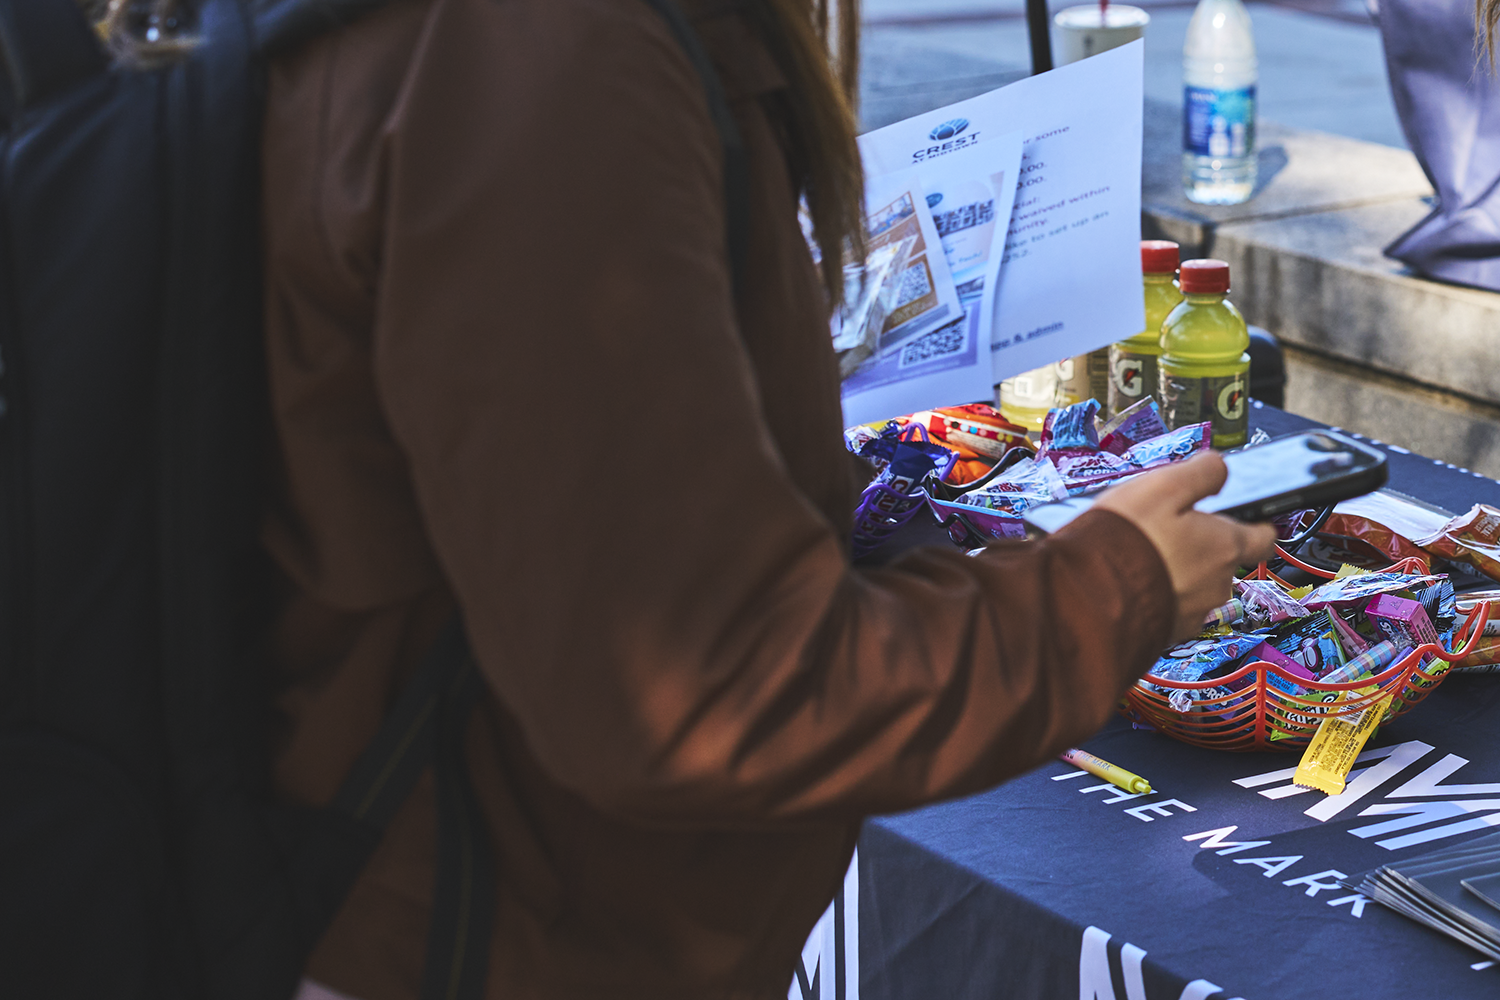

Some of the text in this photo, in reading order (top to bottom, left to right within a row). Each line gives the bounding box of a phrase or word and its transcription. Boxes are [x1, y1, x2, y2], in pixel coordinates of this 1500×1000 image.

[912, 132, 980, 158] CREST
[1035, 126, 1070, 142] some
[928, 140, 978, 160] MIDTOWN
[1116, 359, 1142, 397] G
[1217, 379, 1244, 420] G
[1078, 752, 1090, 763] THE
[1092, 758, 1114, 772] MARK
[1050, 768, 1378, 918] THE MARK
